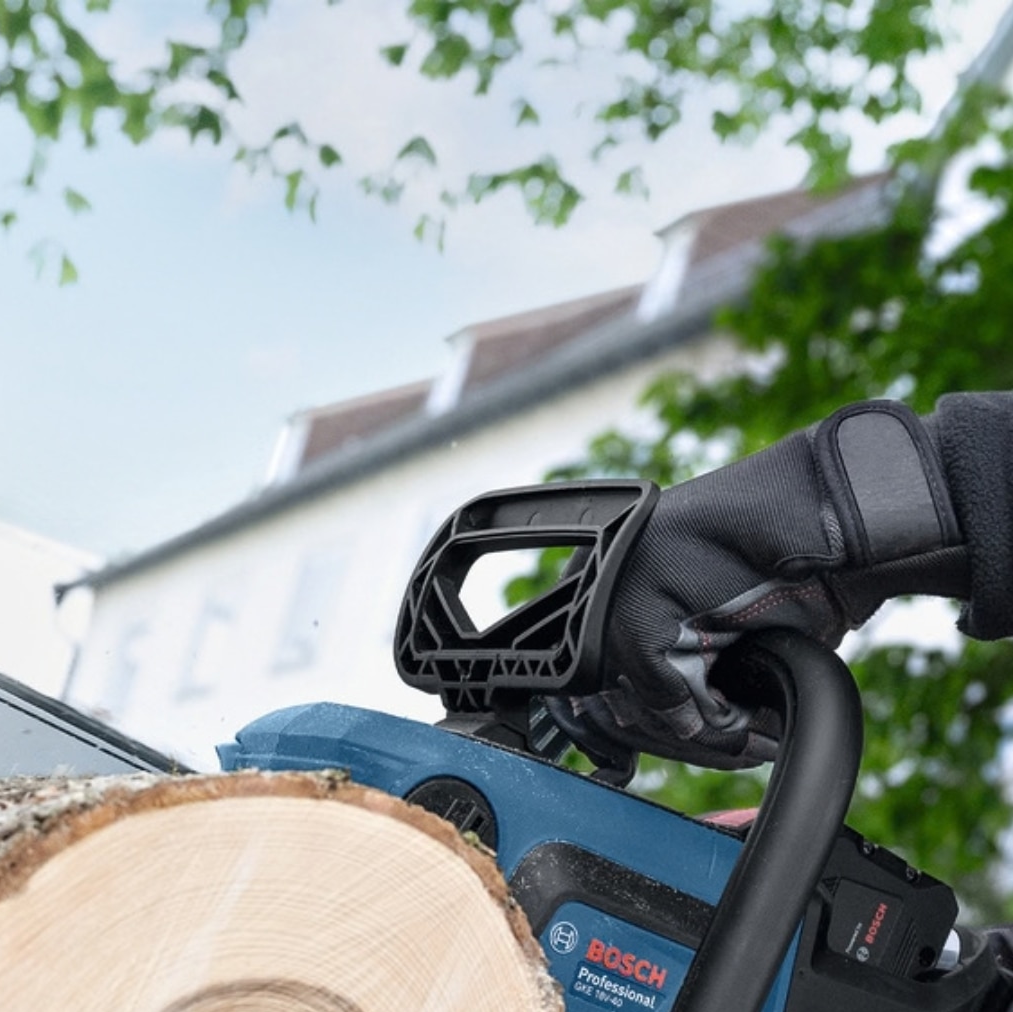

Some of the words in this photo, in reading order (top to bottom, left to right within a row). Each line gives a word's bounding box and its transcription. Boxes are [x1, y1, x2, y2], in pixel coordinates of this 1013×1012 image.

[865, 902, 888, 944] BOSCH
[585, 938, 668, 990] BOSCH
[577, 966, 656, 1009] Professional
